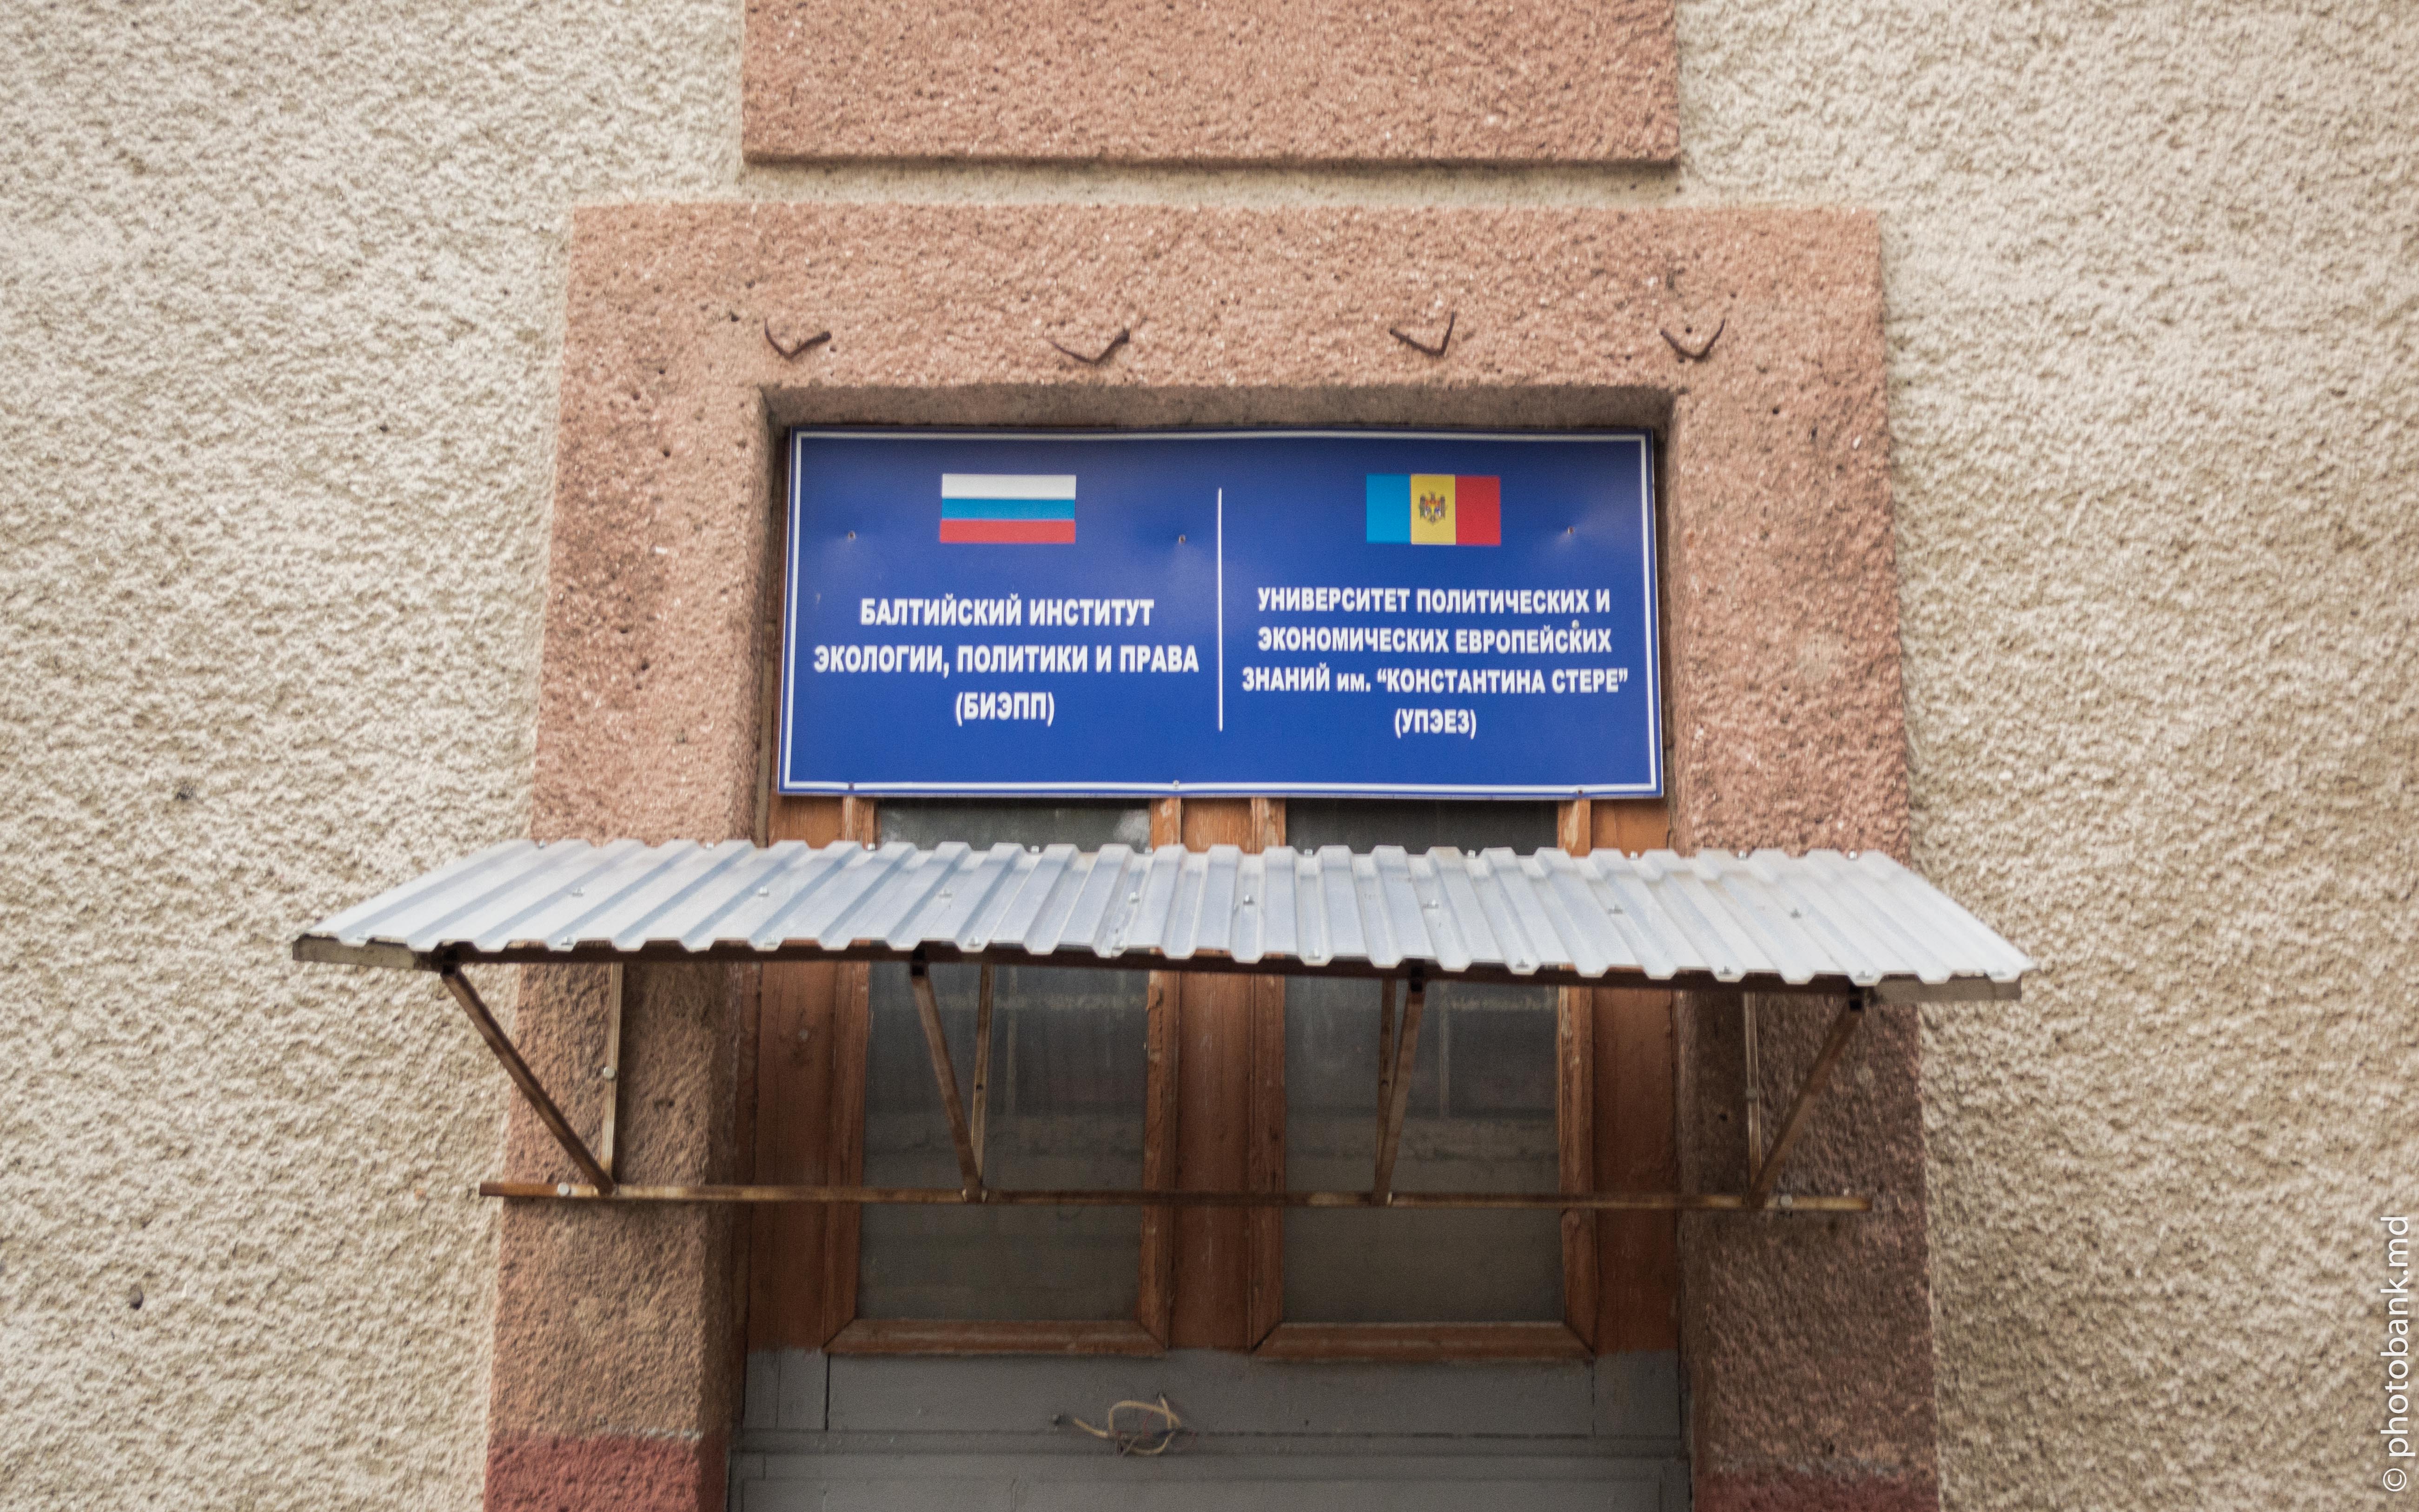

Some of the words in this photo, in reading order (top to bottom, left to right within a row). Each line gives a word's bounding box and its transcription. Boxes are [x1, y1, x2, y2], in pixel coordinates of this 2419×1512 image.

[860, 593, 1022, 626] БАЛТИЙСКИЙ
[1029, 598, 1155, 627] ИНСТИТУТ
[1257, 587, 1410, 612] УНИВЕРСИТЕТ
[1417, 588, 1590, 614] ПОЛИТИЧЕСКИХ
[1596, 589, 1610, 613] И
[1258, 626, 1449, 653] ЭКОНОМИЧЕСКИХ
[1456, 624, 1612, 654] ЕВРОПЕЙСКИХ
[814, 644, 949, 678] ЭКОЛОГИИ,
[957, 644, 1088, 673] ПОЛИТИКИ
[1096, 644, 1112, 672] И
[1120, 644, 1199, 672] ПРАВА
[1242, 662, 1330, 691] ЗНАНИЙ
[1337, 673, 1371, 692] им.
[1377, 668, 1546, 694] “КОНСТАНТИНА
[1551, 668, 1628, 694] СТЕРЕ”
[955, 691, 1054, 727] (БИЭПП)
[1395, 708, 1477, 739] (УПЭЕЗ)
